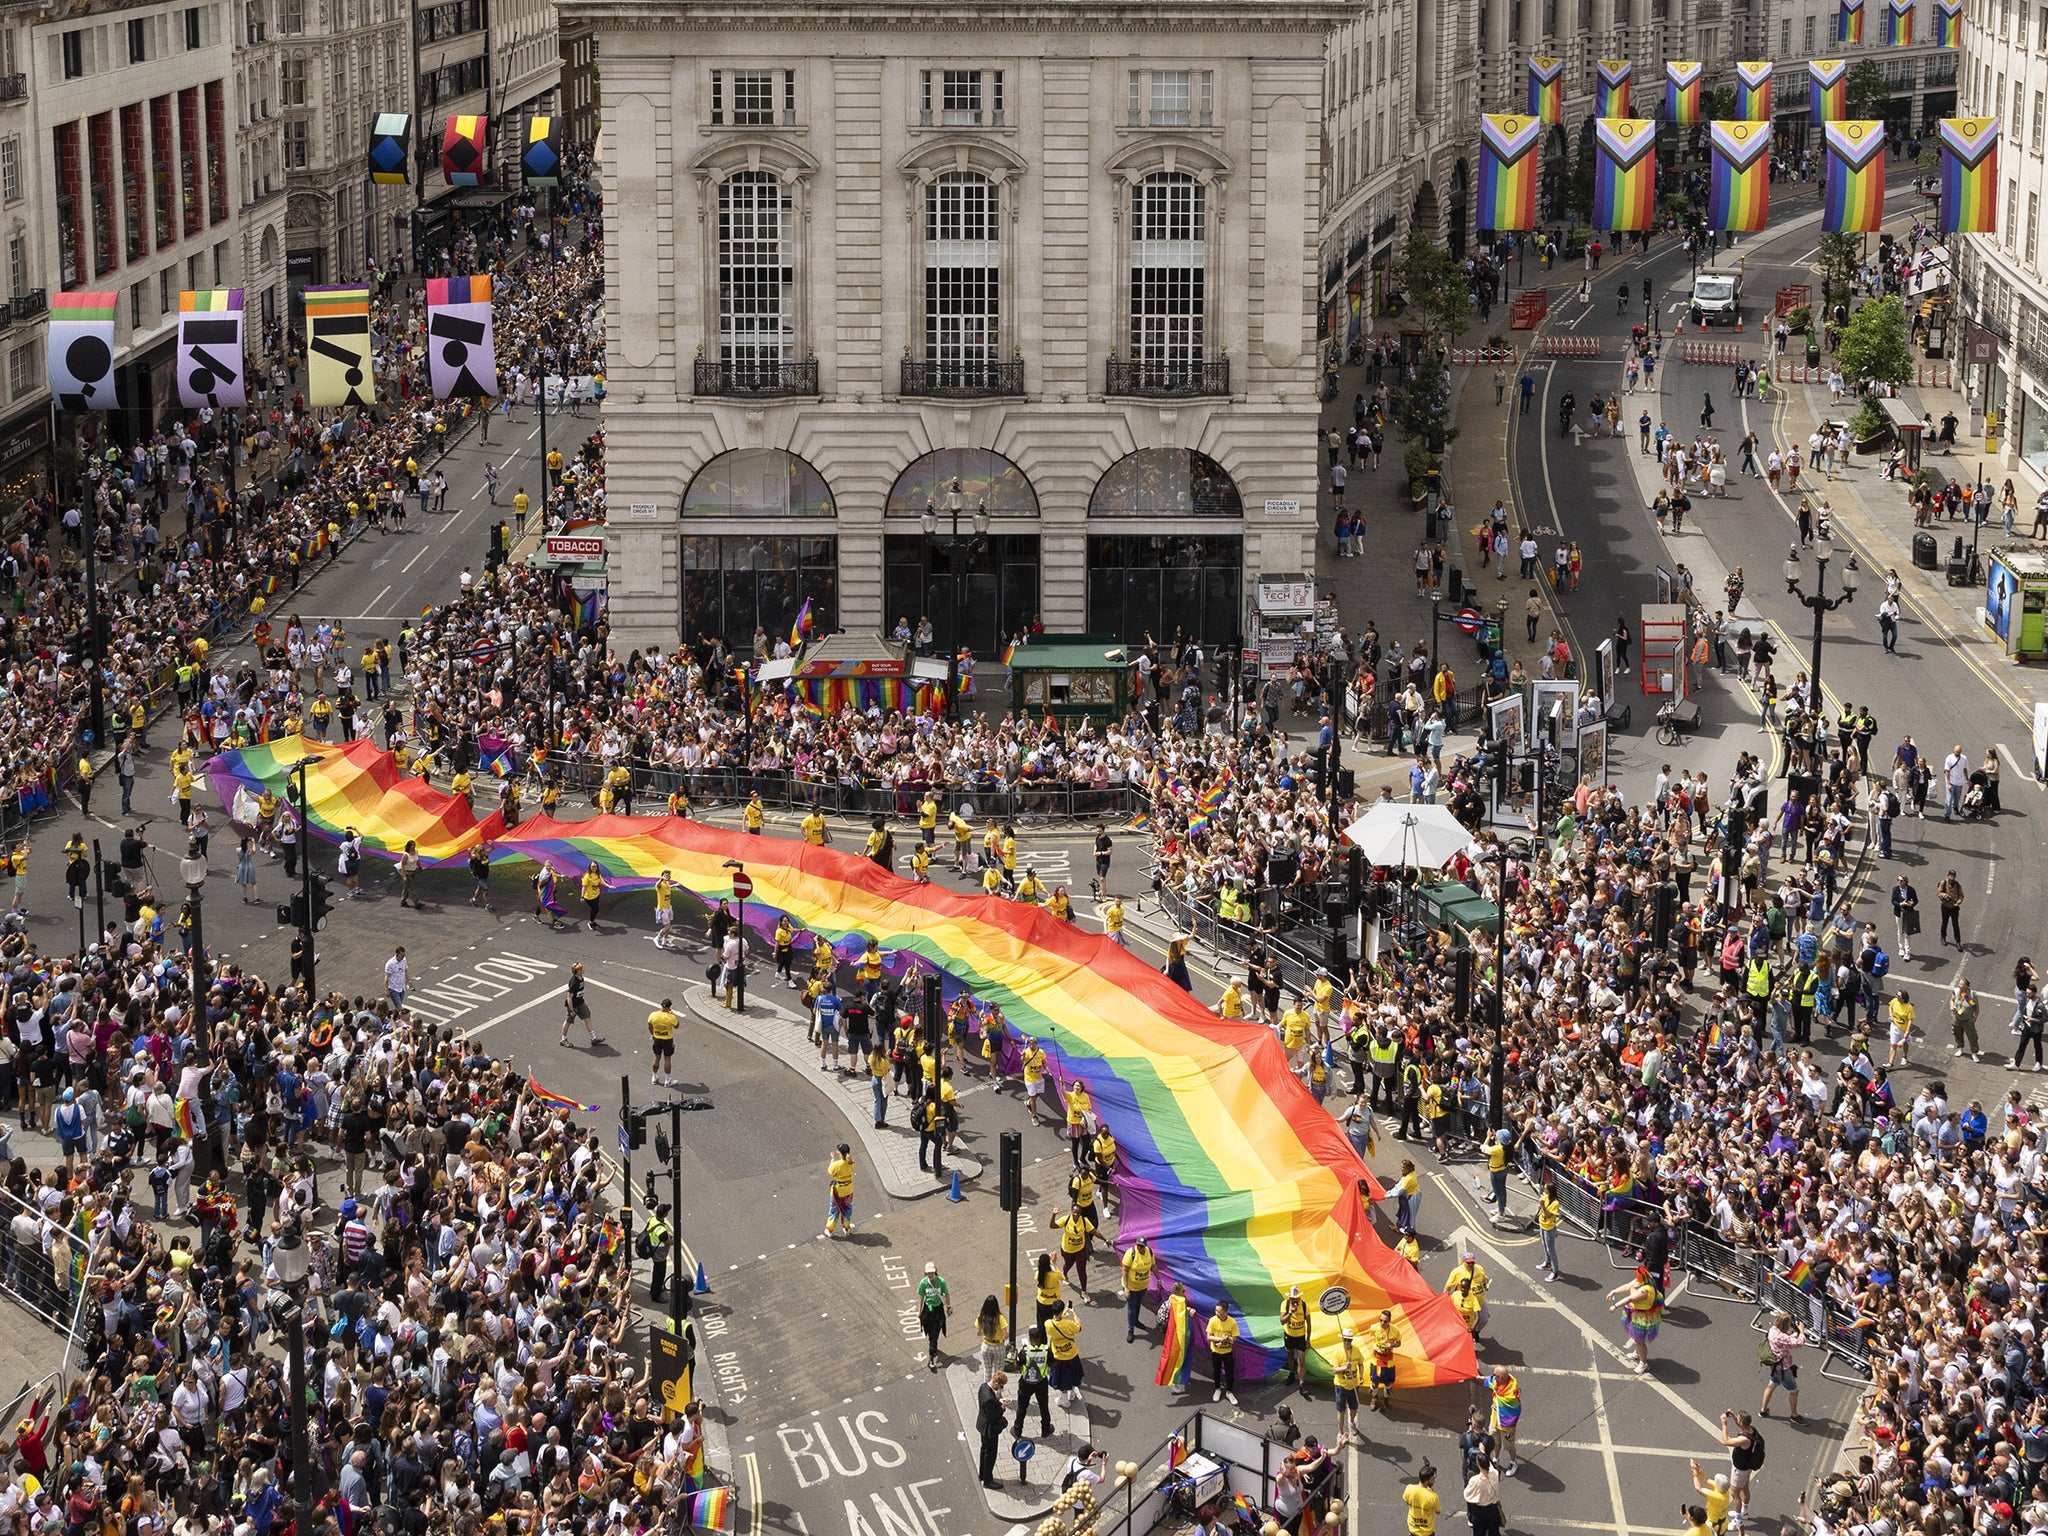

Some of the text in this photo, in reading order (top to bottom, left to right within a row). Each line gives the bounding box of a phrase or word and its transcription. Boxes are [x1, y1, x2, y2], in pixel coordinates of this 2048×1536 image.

[550, 541, 600, 552] TOBACCO
[1264, 592, 1290, 600] TECH
[473, 951, 559, 983] NO
[880, 1255, 911, 1290] LEFT
[699, 1304, 728, 1340] LOOK
[896, 1299, 926, 1341] LOOK
[713, 1351, 748, 1393] RIGHT
[776, 1410, 907, 1489] BUS
